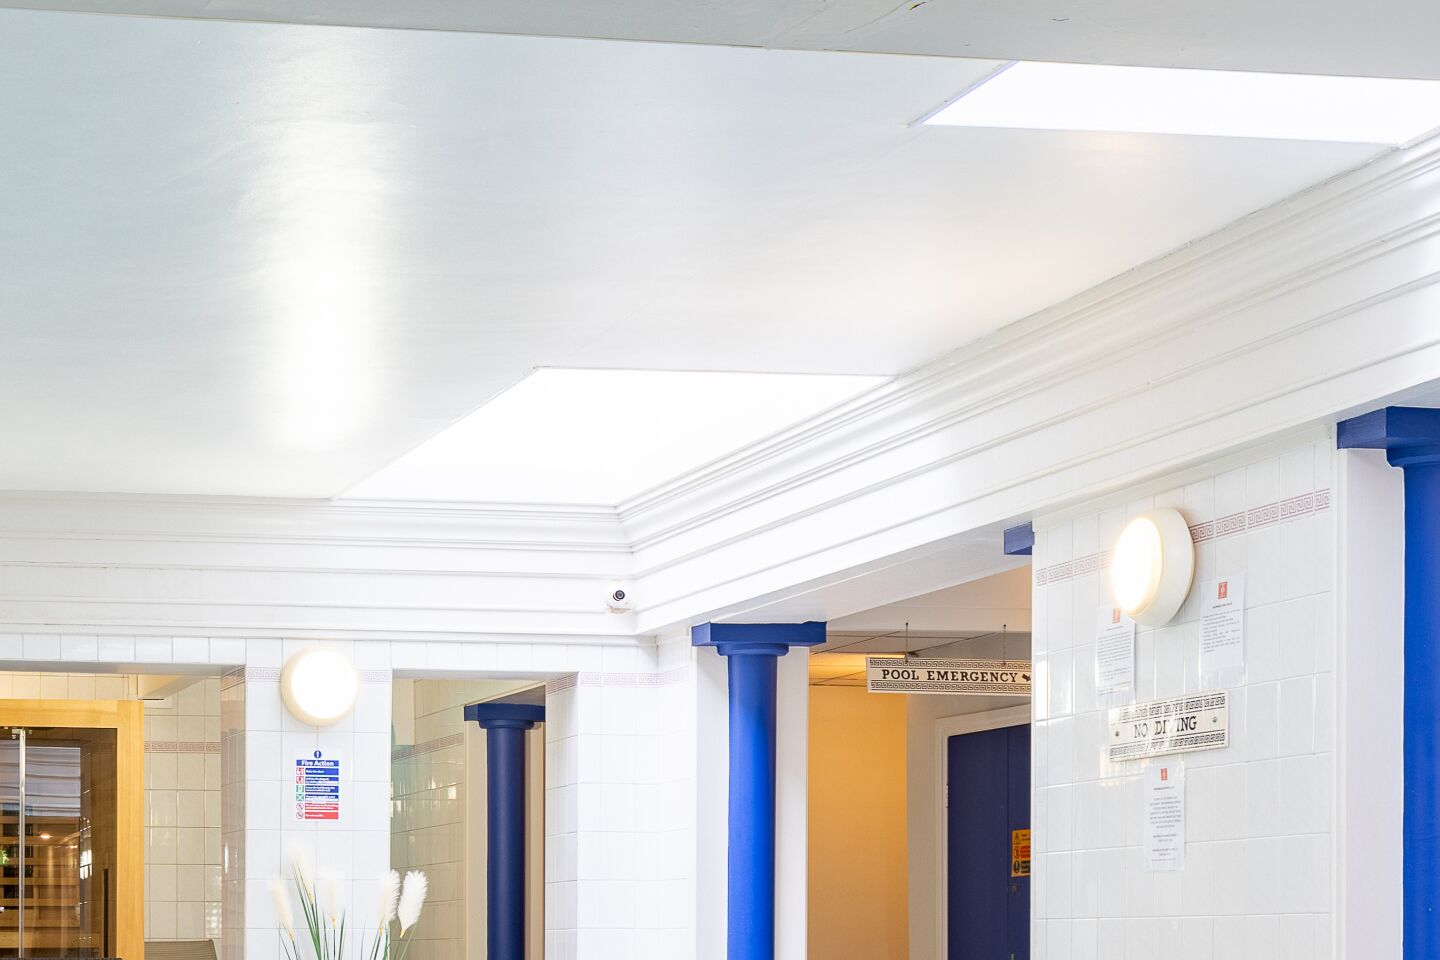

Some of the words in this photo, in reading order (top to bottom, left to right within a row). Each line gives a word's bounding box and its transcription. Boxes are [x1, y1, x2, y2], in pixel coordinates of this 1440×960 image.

[881, 669, 920, 680] POOL
[926, 670, 1019, 683] EMERGENCY
[1133, 722, 1148, 739] NO
[1154, 715, 1198, 736] DIING
